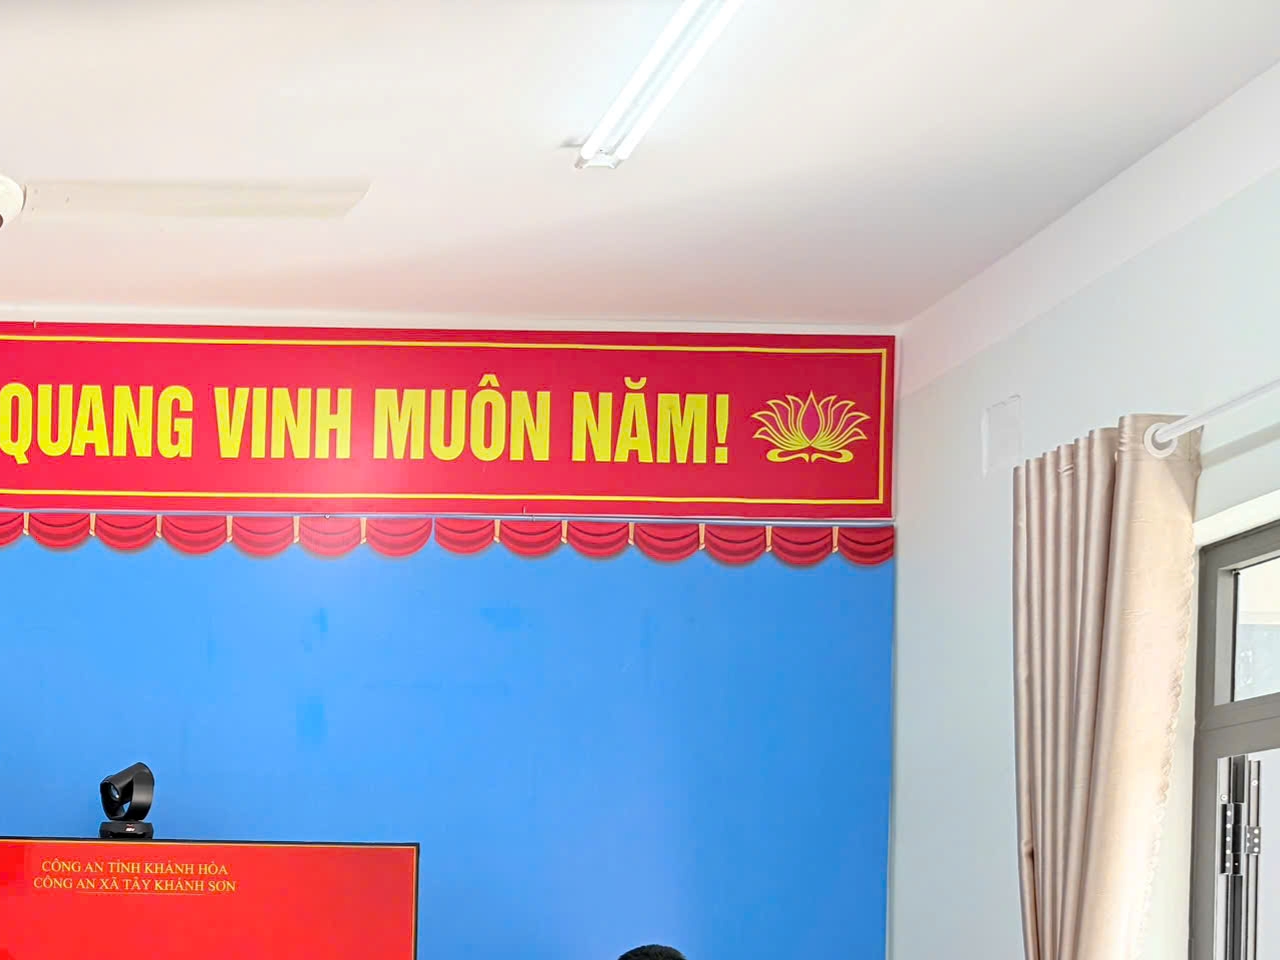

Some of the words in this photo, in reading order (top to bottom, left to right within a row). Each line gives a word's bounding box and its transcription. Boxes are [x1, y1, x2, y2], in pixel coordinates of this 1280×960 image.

[215, 386, 350, 461] VINH
[374, 373, 551, 463] MUÔN
[571, 376, 730, 465] NĂM!
[42, 858, 81, 873] CÔNG
[85, 862, 105, 873] AN
[33, 875, 73, 889] CÔNG
[76, 878, 96, 889] AN
[99, 876, 119, 890] XÃ
[123, 876, 152, 890] TÂY
[154, 877, 204, 891] KHÁNH
[208, 879, 236, 892] SƠN
